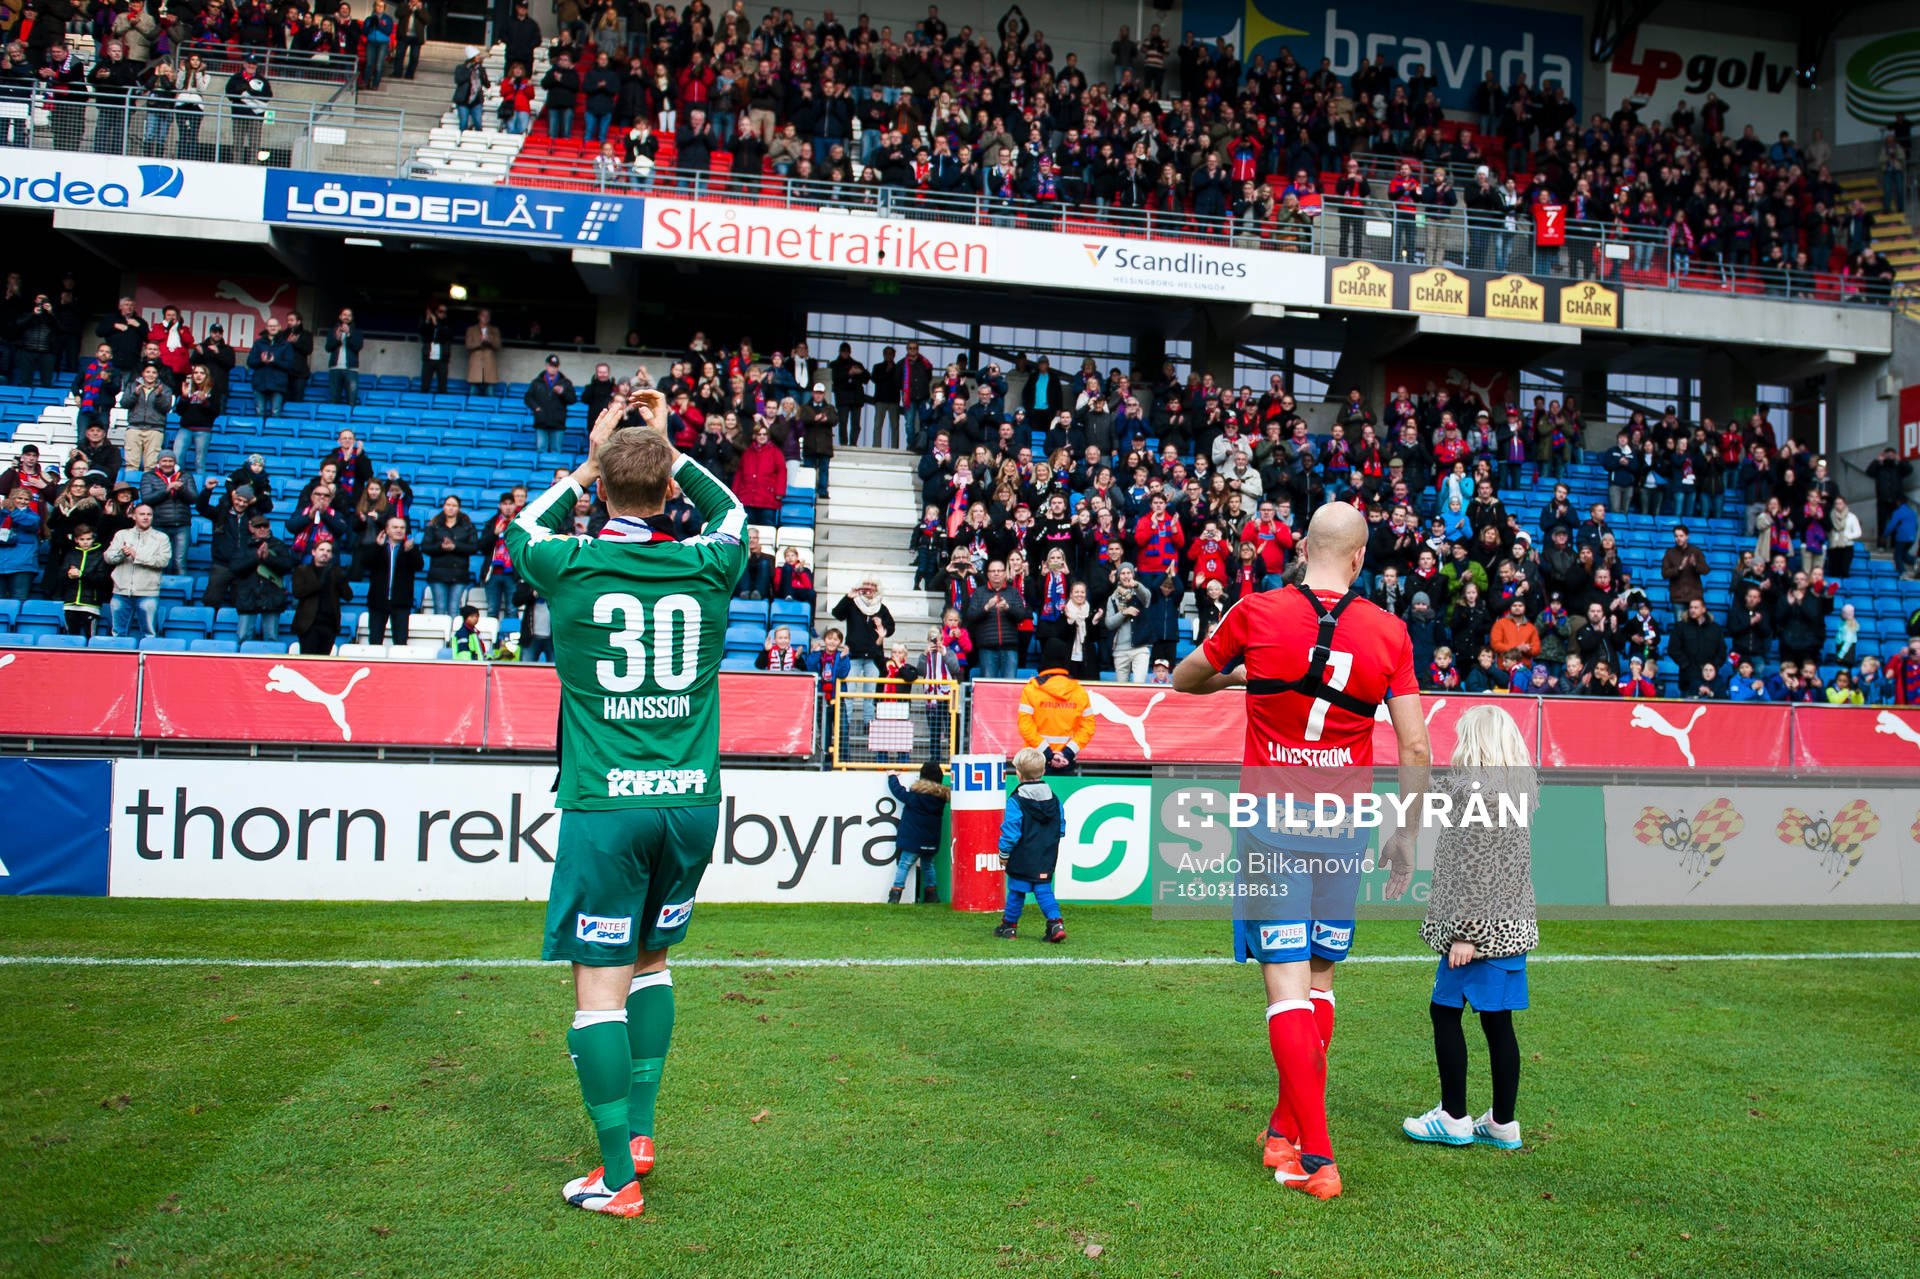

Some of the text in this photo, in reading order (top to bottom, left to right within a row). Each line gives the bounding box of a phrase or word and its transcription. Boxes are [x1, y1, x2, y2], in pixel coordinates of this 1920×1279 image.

[1324, 9, 1572, 99] bravida
[1684, 50, 1795, 95] golv
[287, 182, 566, 230] LÖDDEPLÅT
[655, 207, 989, 275] Skånetrafiken
[1114, 248, 1247, 278] Scandlines
[1338, 279, 1387, 298] CHARK
[1415, 286, 1463, 304] CHARK
[1492, 292, 1539, 311] CHARK
[1566, 299, 1612, 317] CHARK
[141, 306, 256, 349] PMA
[592, 592, 703, 693] 30
[603, 694, 690, 720] HANSSON
[1304, 647, 1354, 742] 7
[607, 778, 708, 797] KRAFT
[125, 786, 387, 862] thorn
[975, 853, 1005, 873] PU
[596, 931, 625, 940] SPORT
[597, 921, 626, 931] INTER
